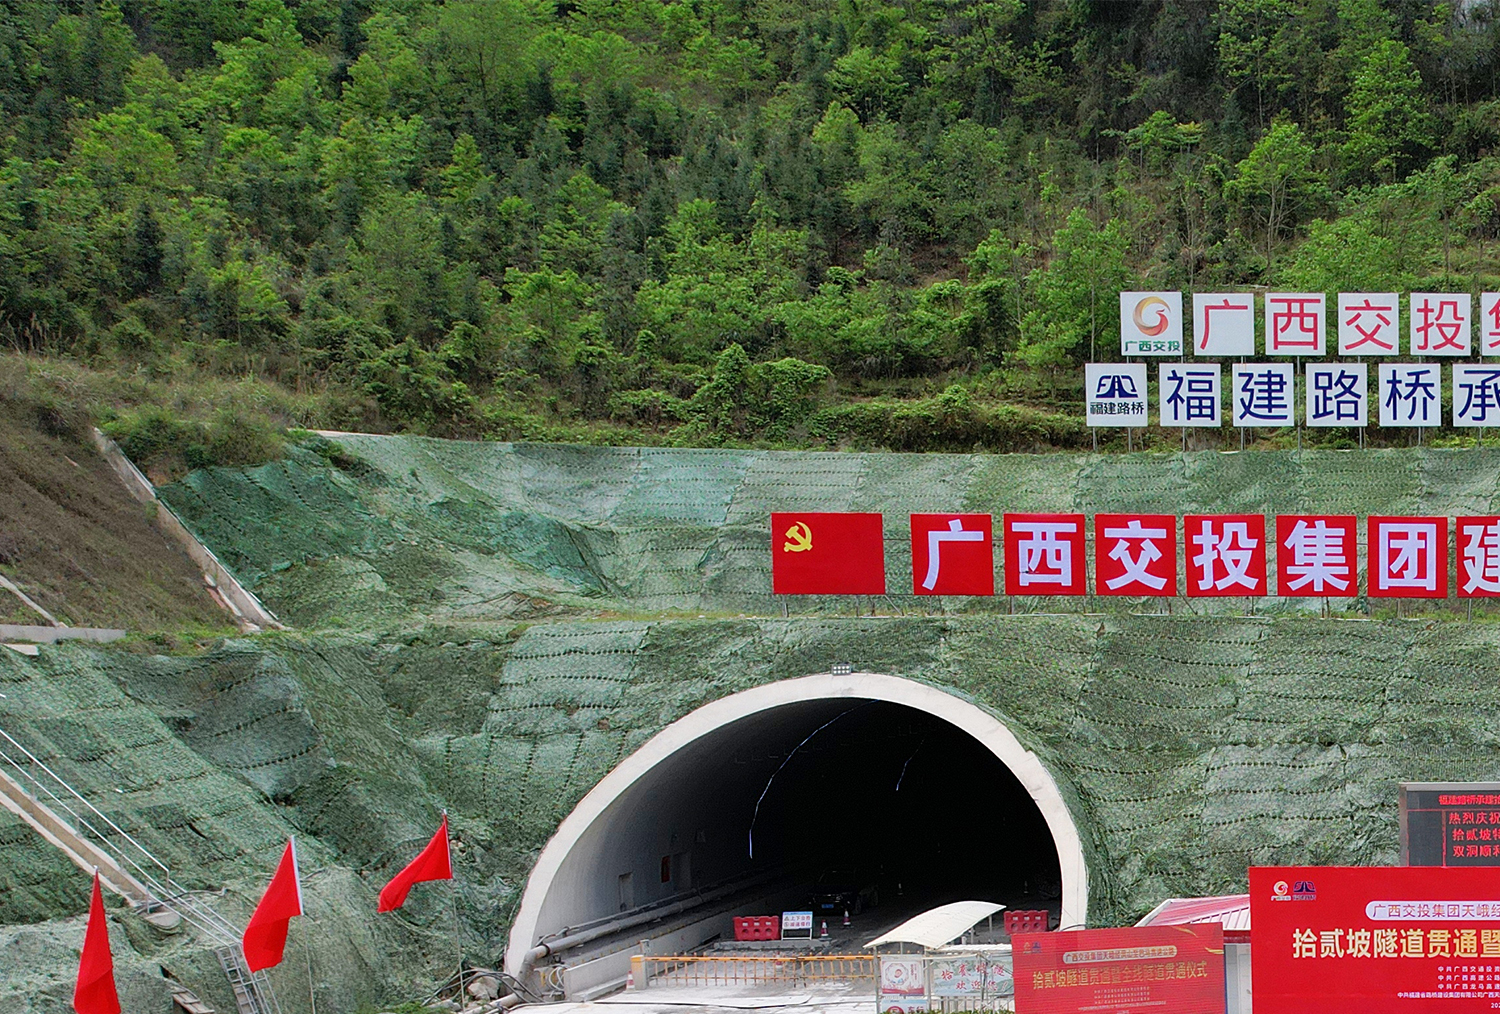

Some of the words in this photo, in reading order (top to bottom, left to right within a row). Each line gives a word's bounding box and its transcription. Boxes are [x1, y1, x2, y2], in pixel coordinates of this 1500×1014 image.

[1125, 340, 1181, 352] 广西交投
[1090, 401, 1144, 415] 福建路桥
